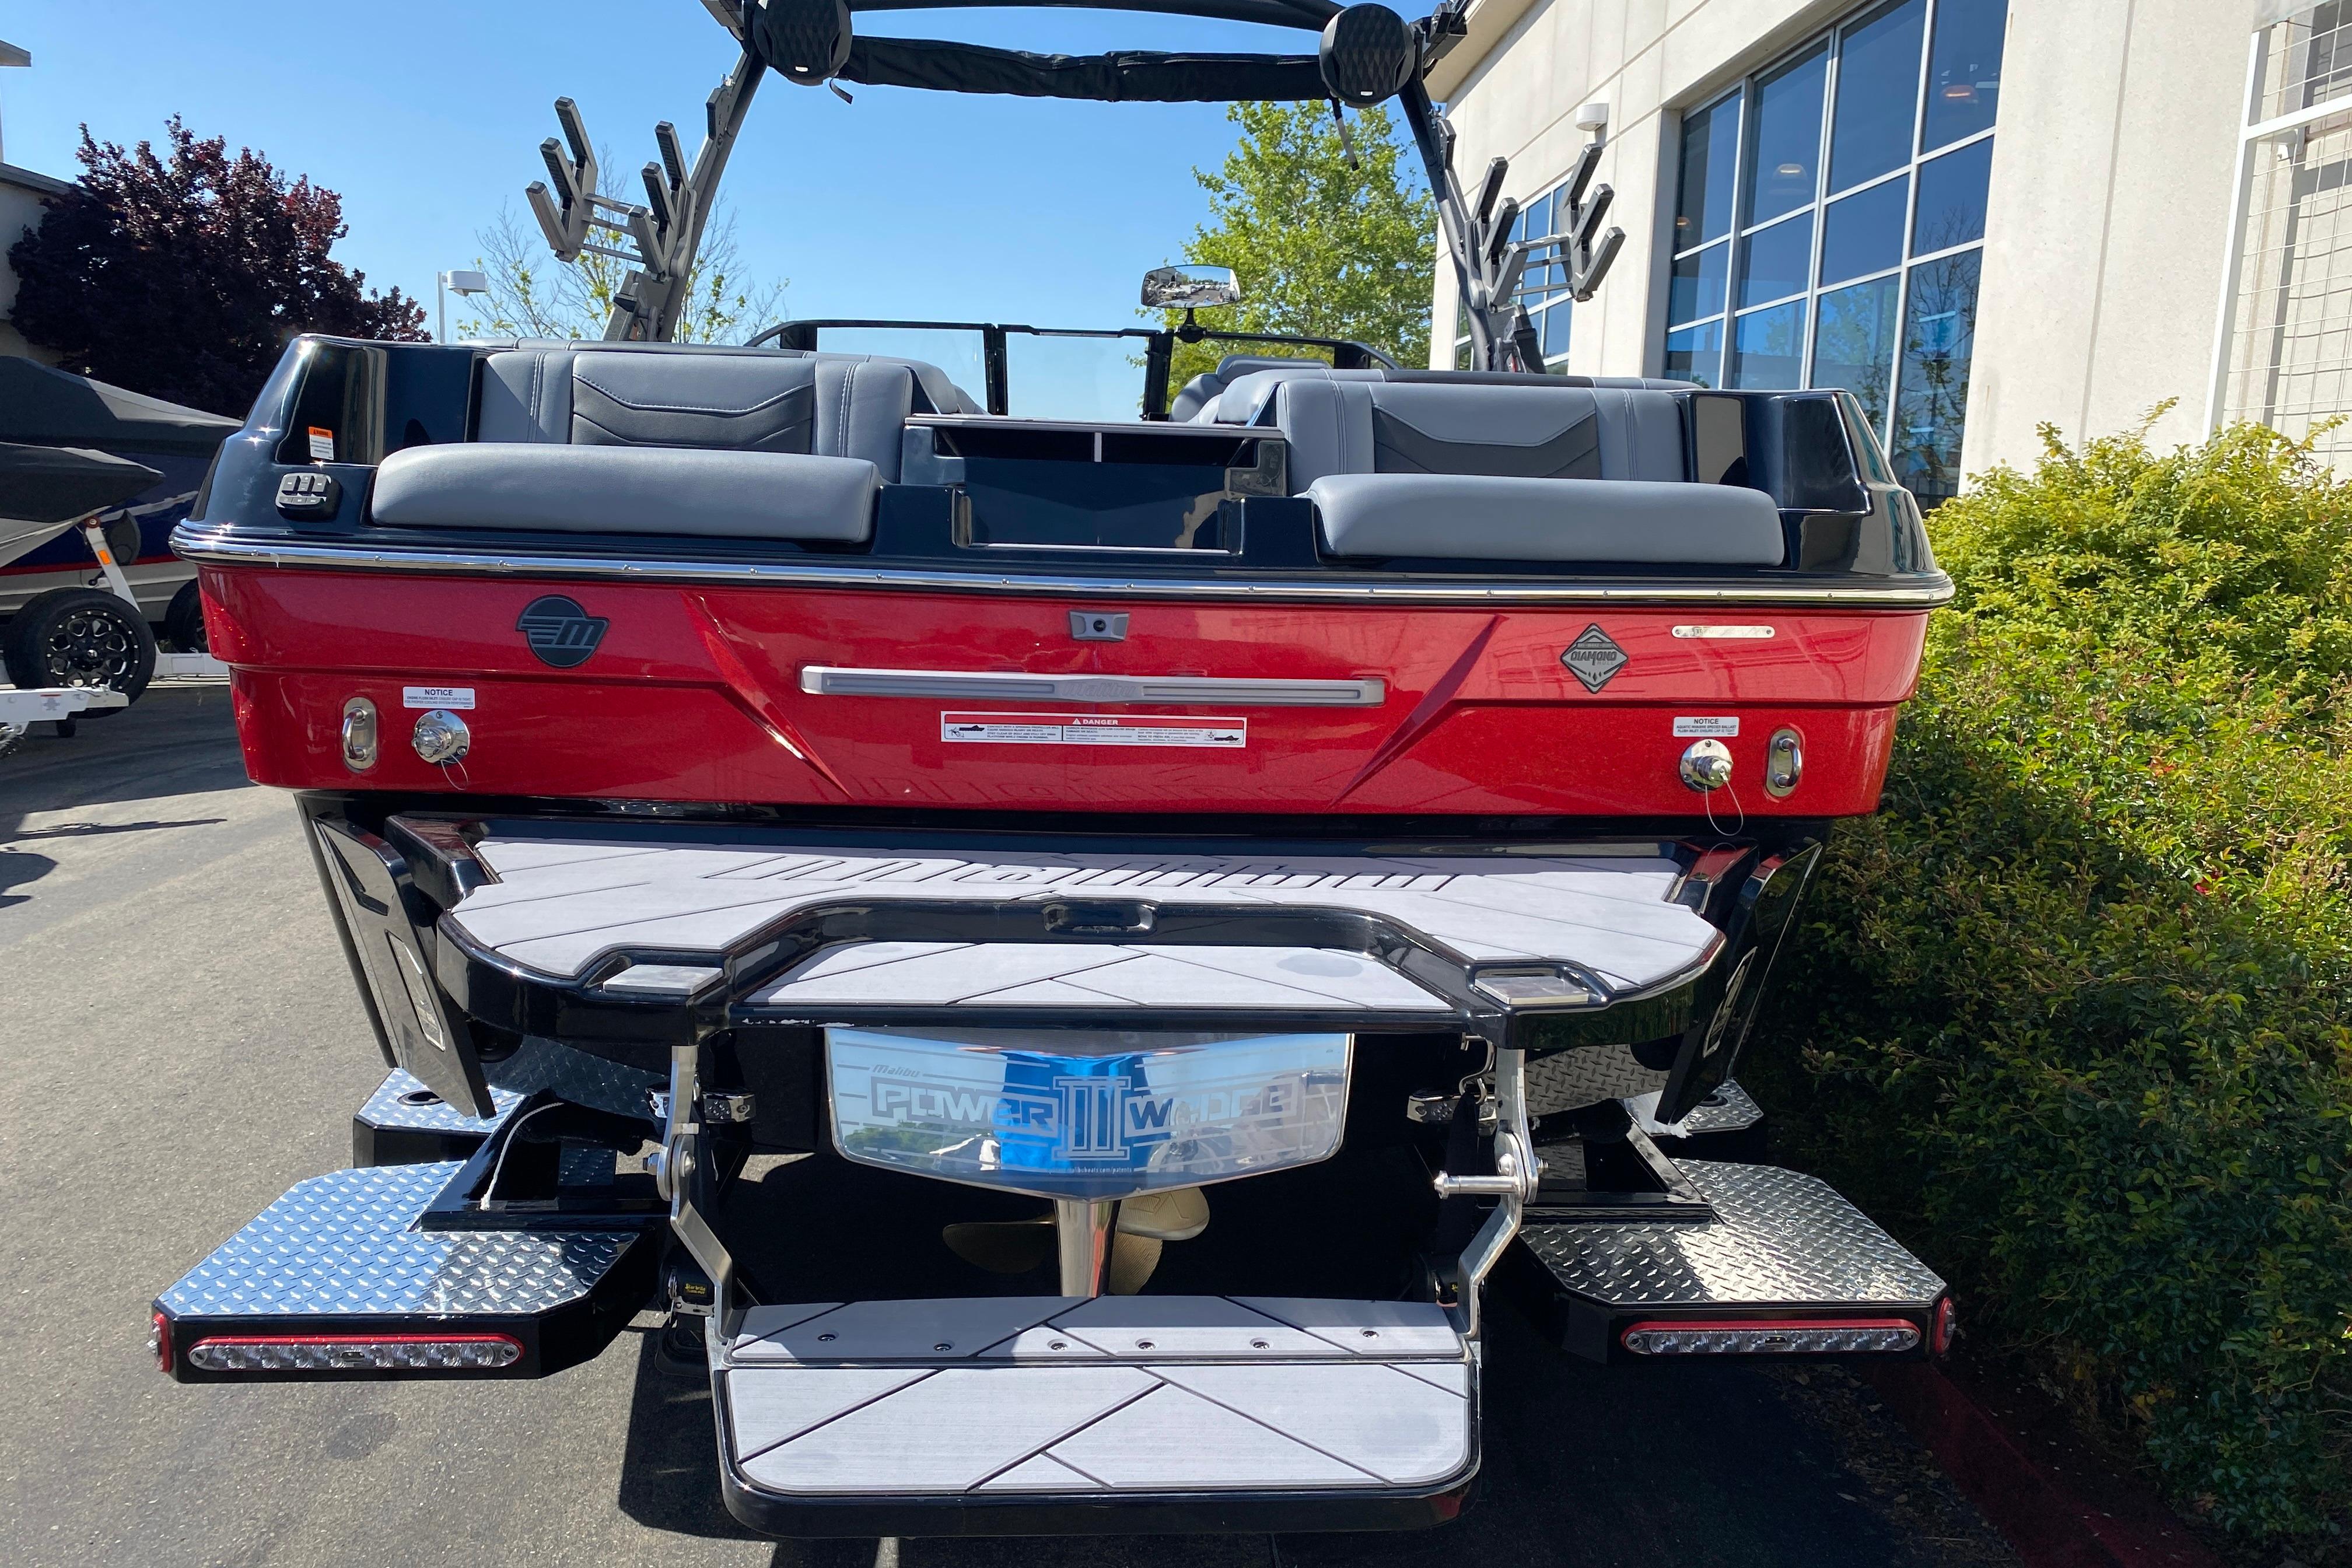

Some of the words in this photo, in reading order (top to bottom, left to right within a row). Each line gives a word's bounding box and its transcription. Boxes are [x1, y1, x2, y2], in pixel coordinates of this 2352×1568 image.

[1570, 651, 1617, 666] DIAMOND
[875, 1081, 1055, 1133] POWER
[1128, 1080, 1294, 1130] WEDGE
